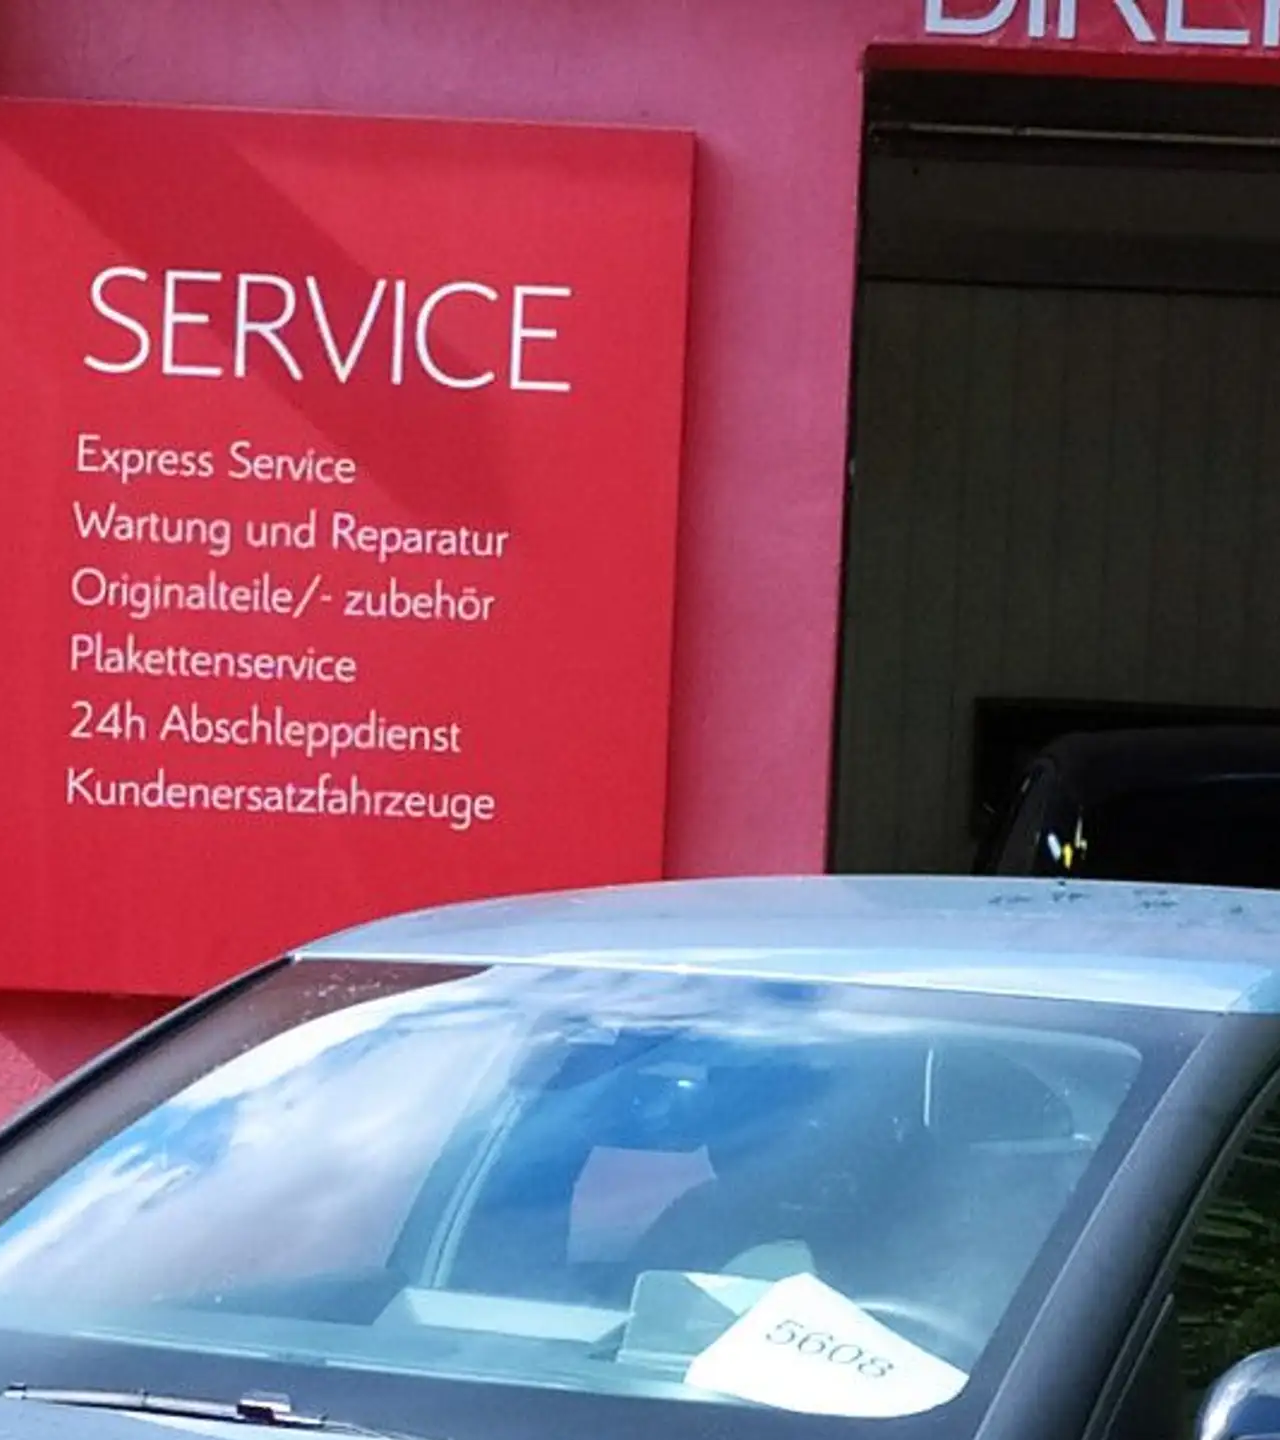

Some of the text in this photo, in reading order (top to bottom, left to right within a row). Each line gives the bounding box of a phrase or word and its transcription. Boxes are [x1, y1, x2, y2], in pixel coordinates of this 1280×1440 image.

[83, 266, 572, 392] SERVICE
[76, 434, 357, 484] Express Service
[73, 501, 510, 562] Wartung und Reparatur
[70, 633, 357, 682] Plakettenservice
[70, 700, 462, 757] 24h Abschleppdienst
[66, 767, 496, 830] Kundenersatzfahrzeuge
[765, 1318, 895, 1379] 5608
